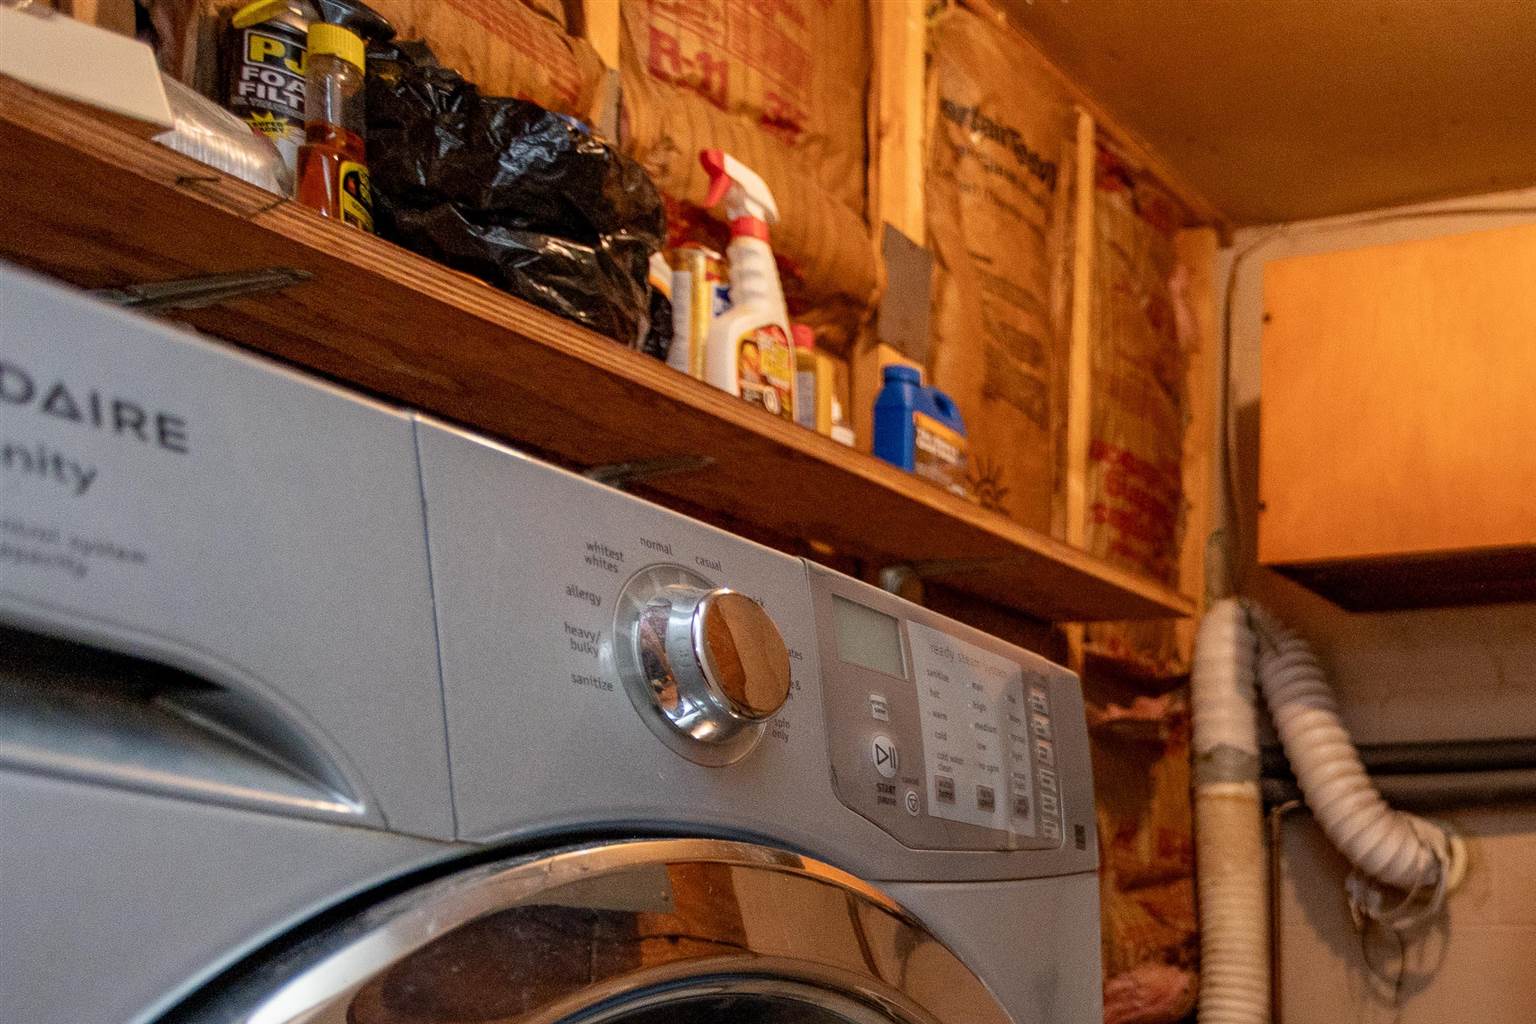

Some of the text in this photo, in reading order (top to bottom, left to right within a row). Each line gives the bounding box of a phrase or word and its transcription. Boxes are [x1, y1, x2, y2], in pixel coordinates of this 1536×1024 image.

[0, 360, 190, 454] DAIRE
[585, 541, 625, 563] whitest
[639, 536, 673, 557] normal
[584, 554, 619, 574] whites
[695, 555, 723, 573] casual
[565, 584, 602, 606] allergy
[564, 621, 601, 645] heavy/
[570, 639, 600, 658] bulky
[571, 673, 615, 692] sanitize
